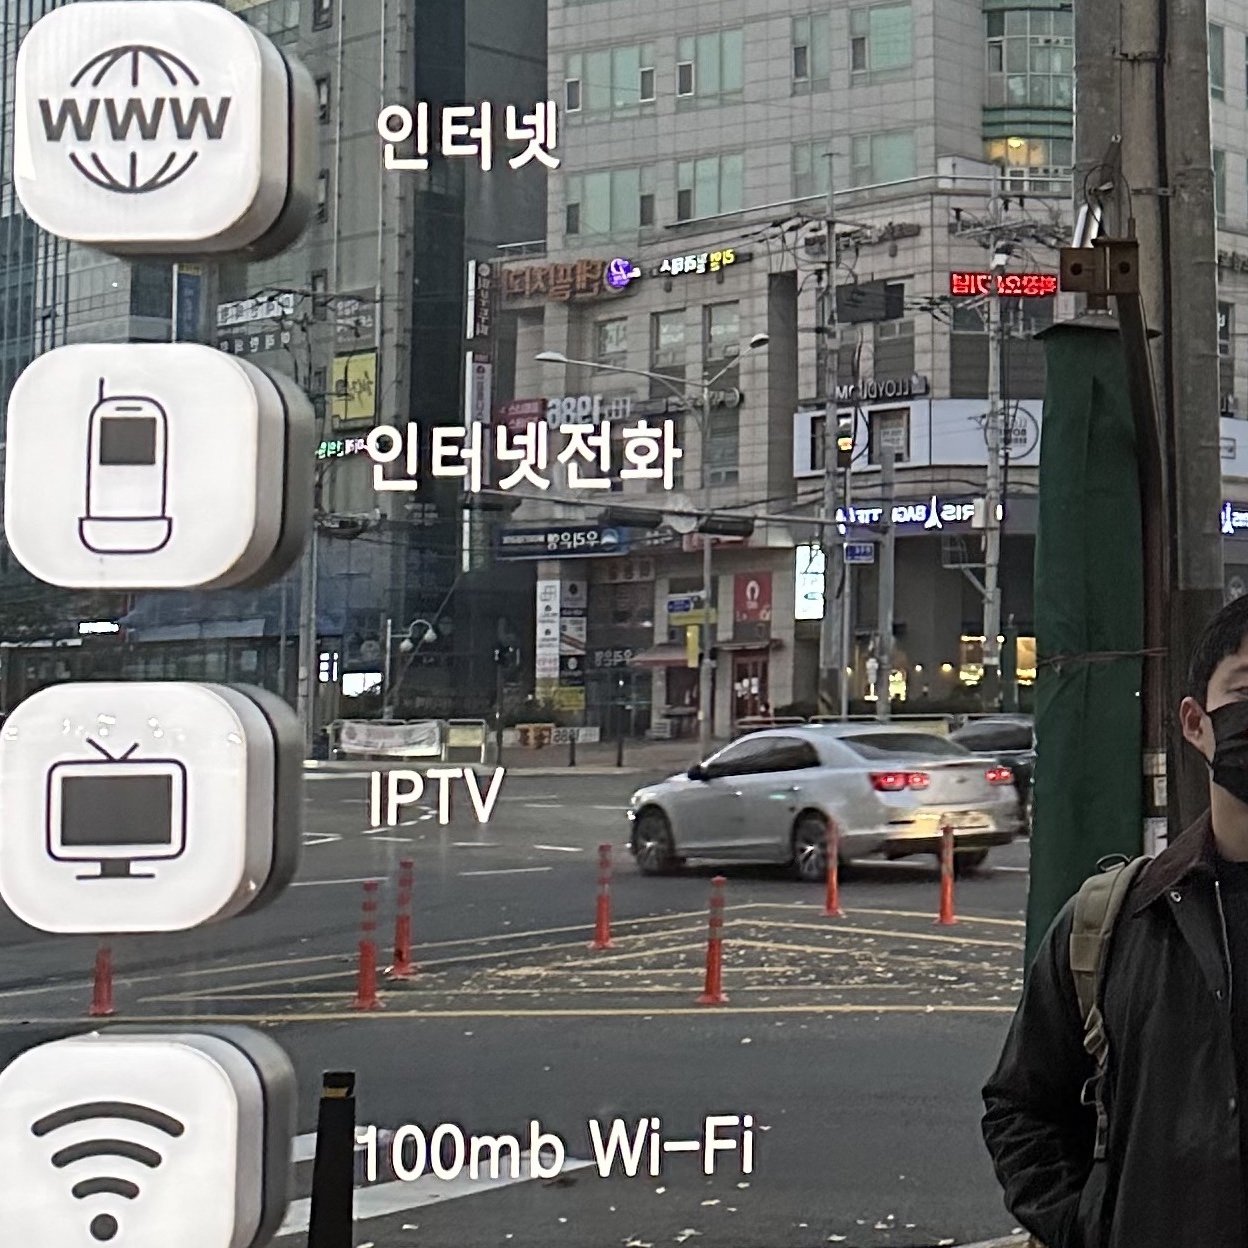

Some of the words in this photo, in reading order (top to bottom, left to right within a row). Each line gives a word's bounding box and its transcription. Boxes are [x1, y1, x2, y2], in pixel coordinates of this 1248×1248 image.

[378, 101, 560, 170] 인터넷
[366, 419, 683, 492] 인터넷전화
[371, 766, 505, 827] IPTV
[357, 1120, 565, 1182] 100mb
[590, 1115, 753, 1177] Wi-Fi
